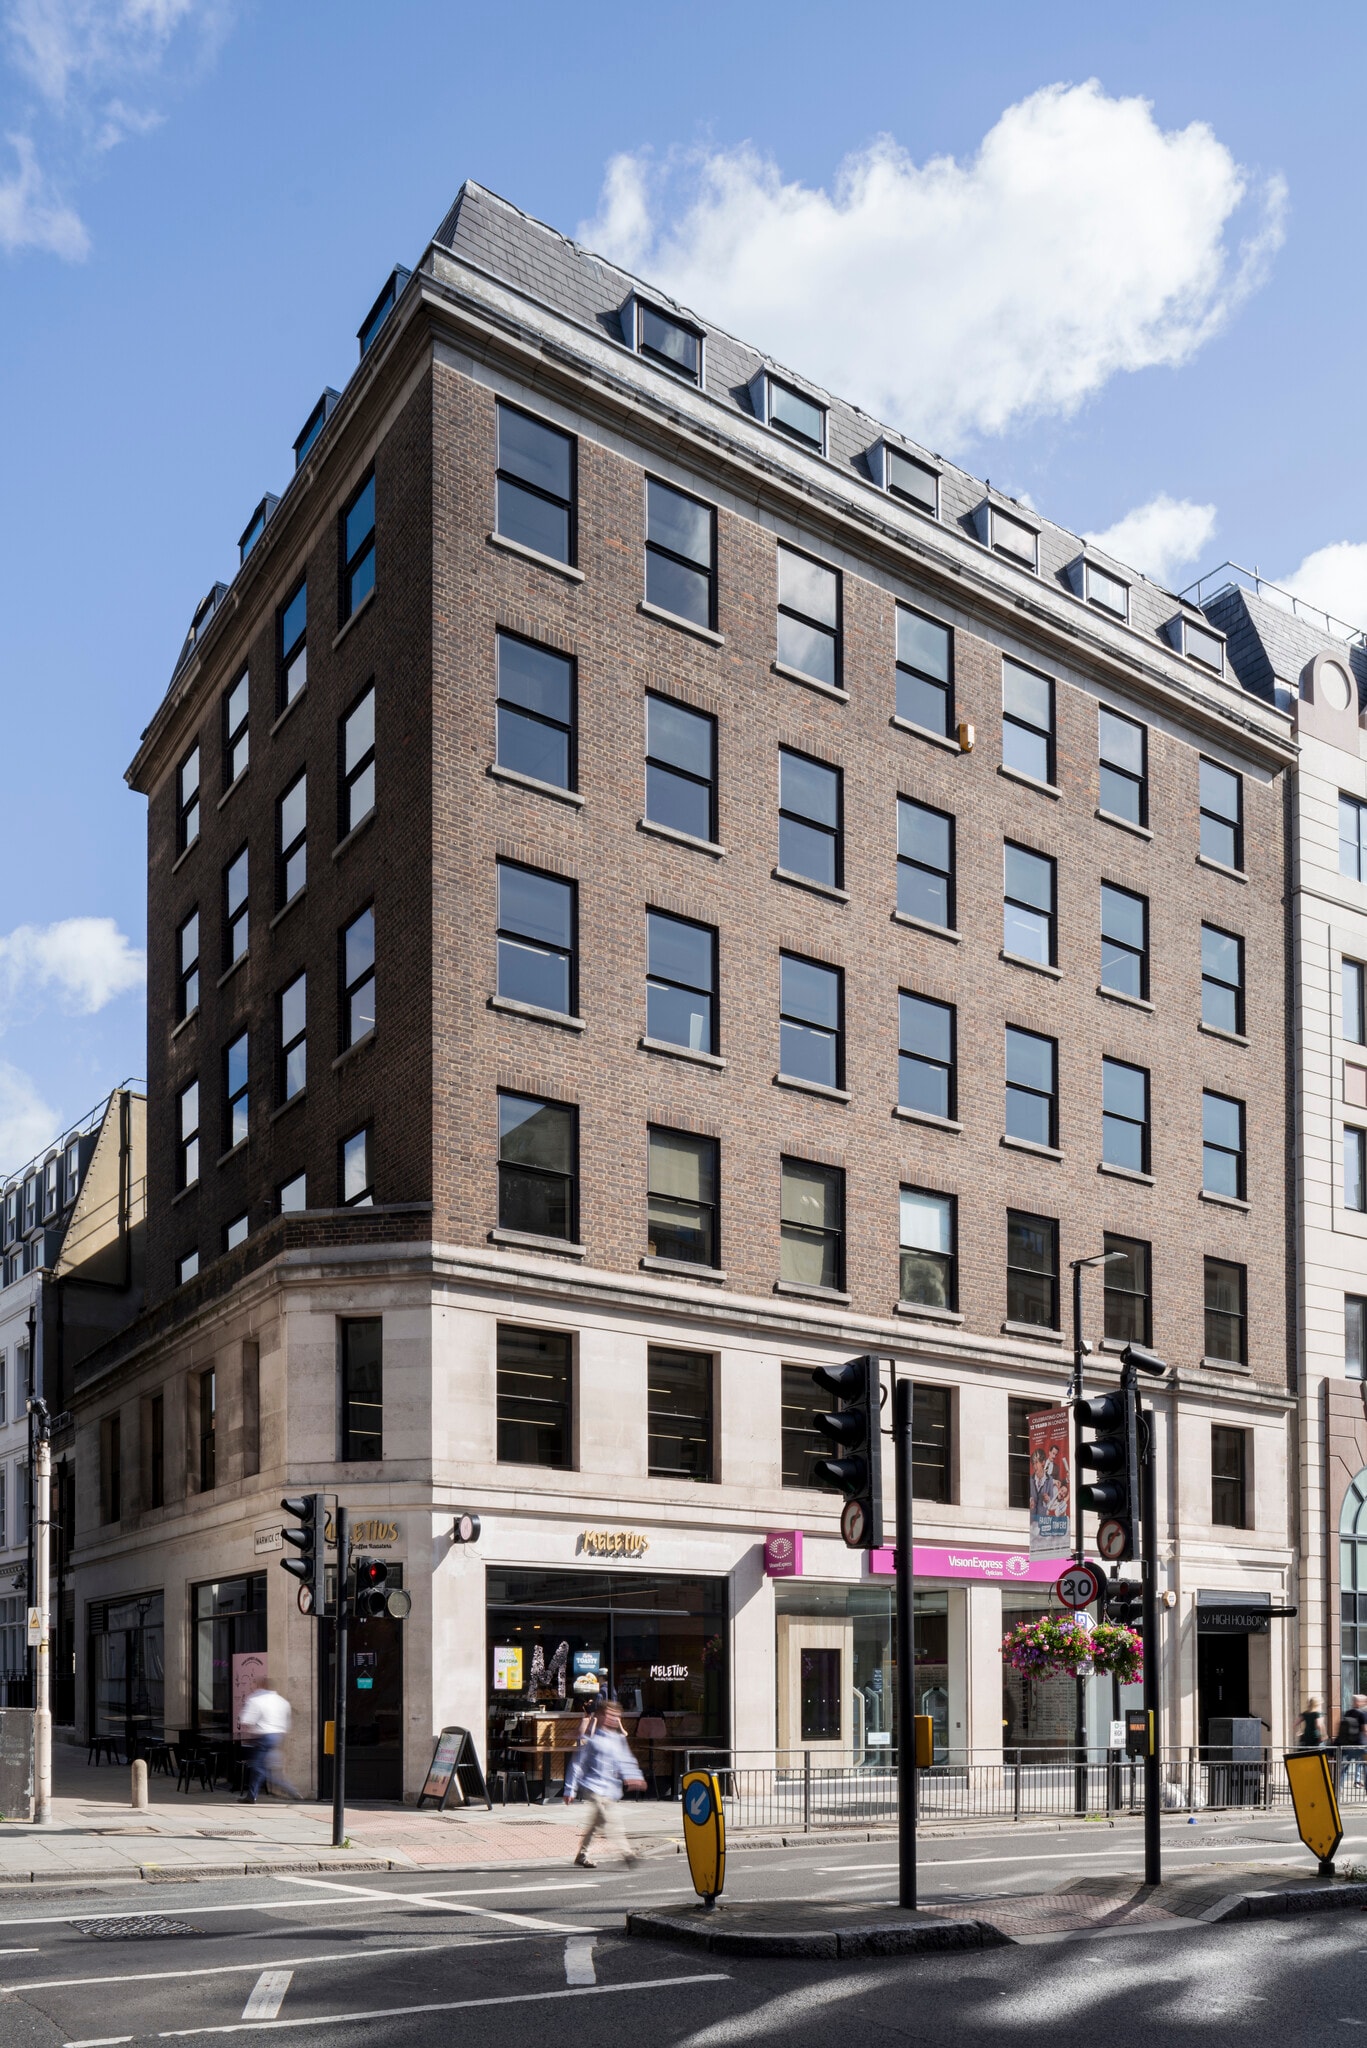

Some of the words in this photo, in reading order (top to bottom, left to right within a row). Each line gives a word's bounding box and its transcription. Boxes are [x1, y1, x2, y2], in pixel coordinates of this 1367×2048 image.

[1031, 1414, 1056, 1424] CELEBRATING
[1052, 1418, 1069, 1426] LONDON
[1052, 1521, 1067, 1529] TOWERS
[256, 1534, 274, 1545] WARWICK
[948, 1555, 1004, 1571] VisionExpress
[985, 1569, 1004, 1577] Opticians
[1063, 1578, 1092, 1597] 20
[1212, 1614, 1231, 1625] HIGH
[1129, 1723, 1146, 1731] WAIT
